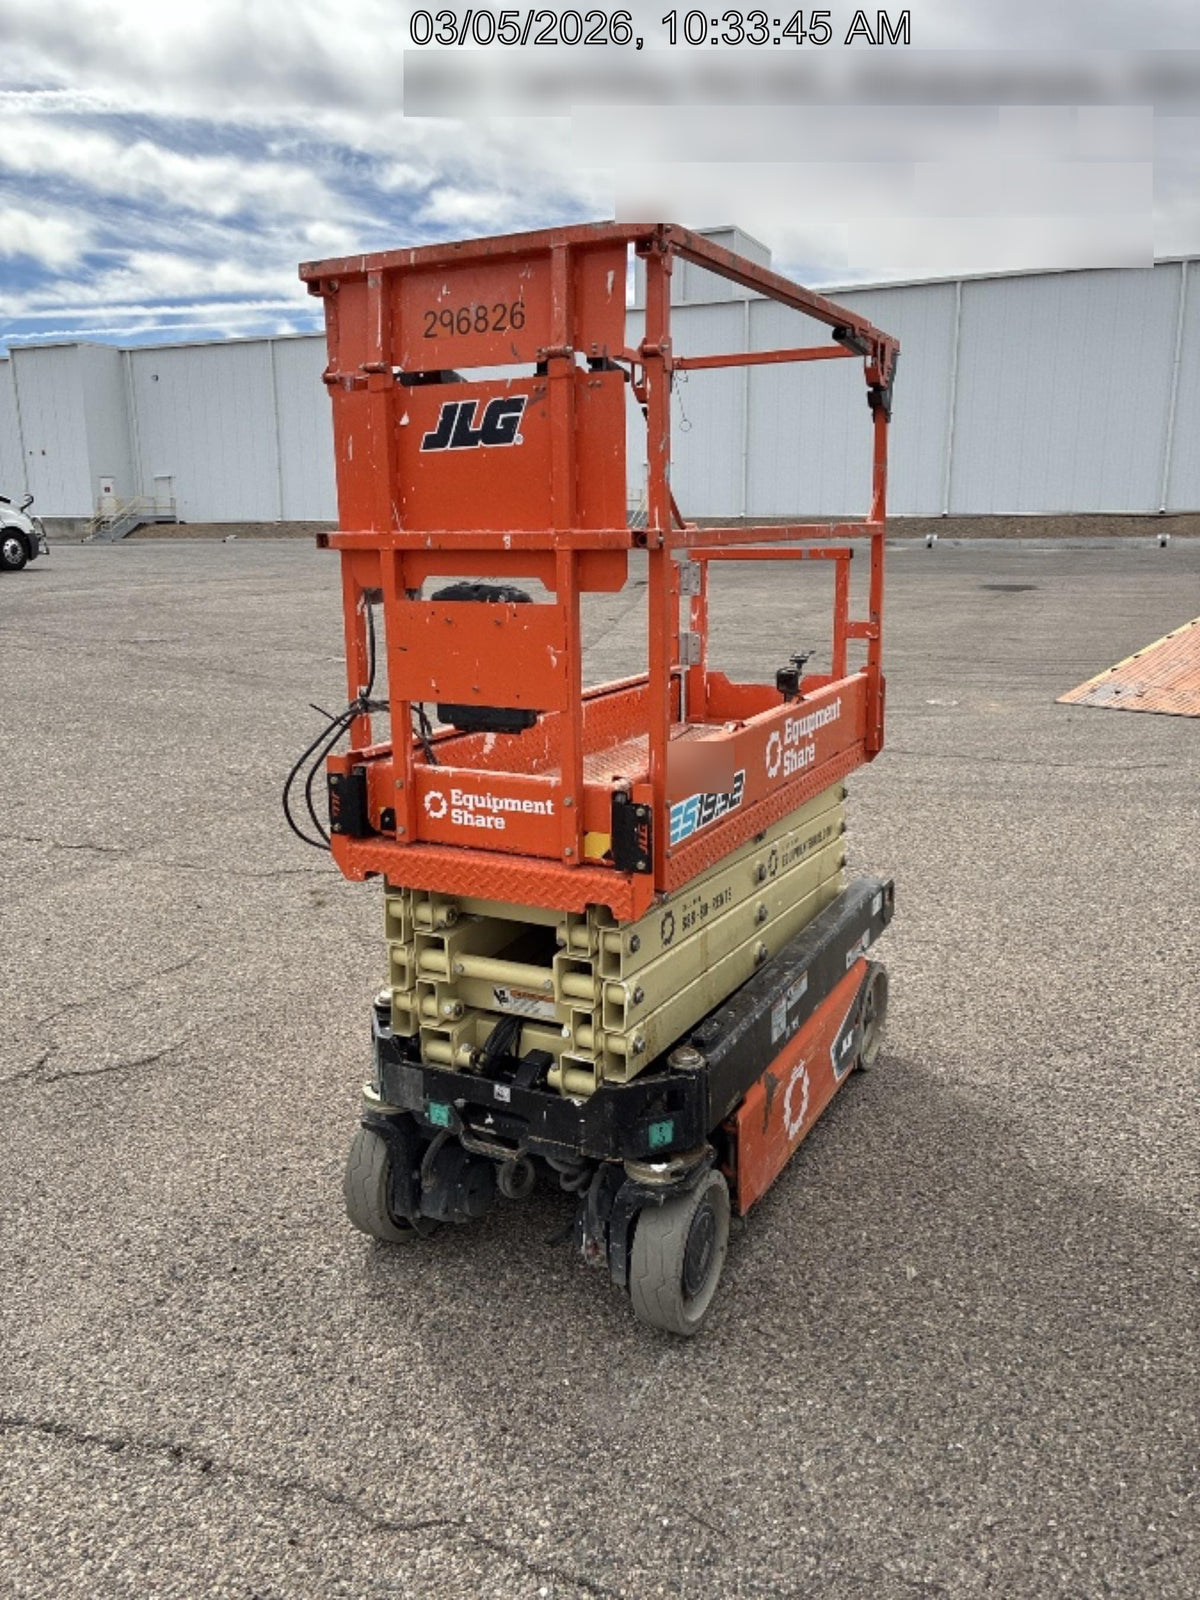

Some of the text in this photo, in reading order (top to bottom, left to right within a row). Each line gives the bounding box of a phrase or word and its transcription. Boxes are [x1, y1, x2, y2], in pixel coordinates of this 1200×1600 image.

[423, 301, 526, 338] 296826
[419, 394, 528, 452] JLG
[784, 696, 842, 746] Equipment
[783, 742, 816, 778] Share
[450, 788, 555, 815] Equipment
[450, 808, 506, 830] Share
